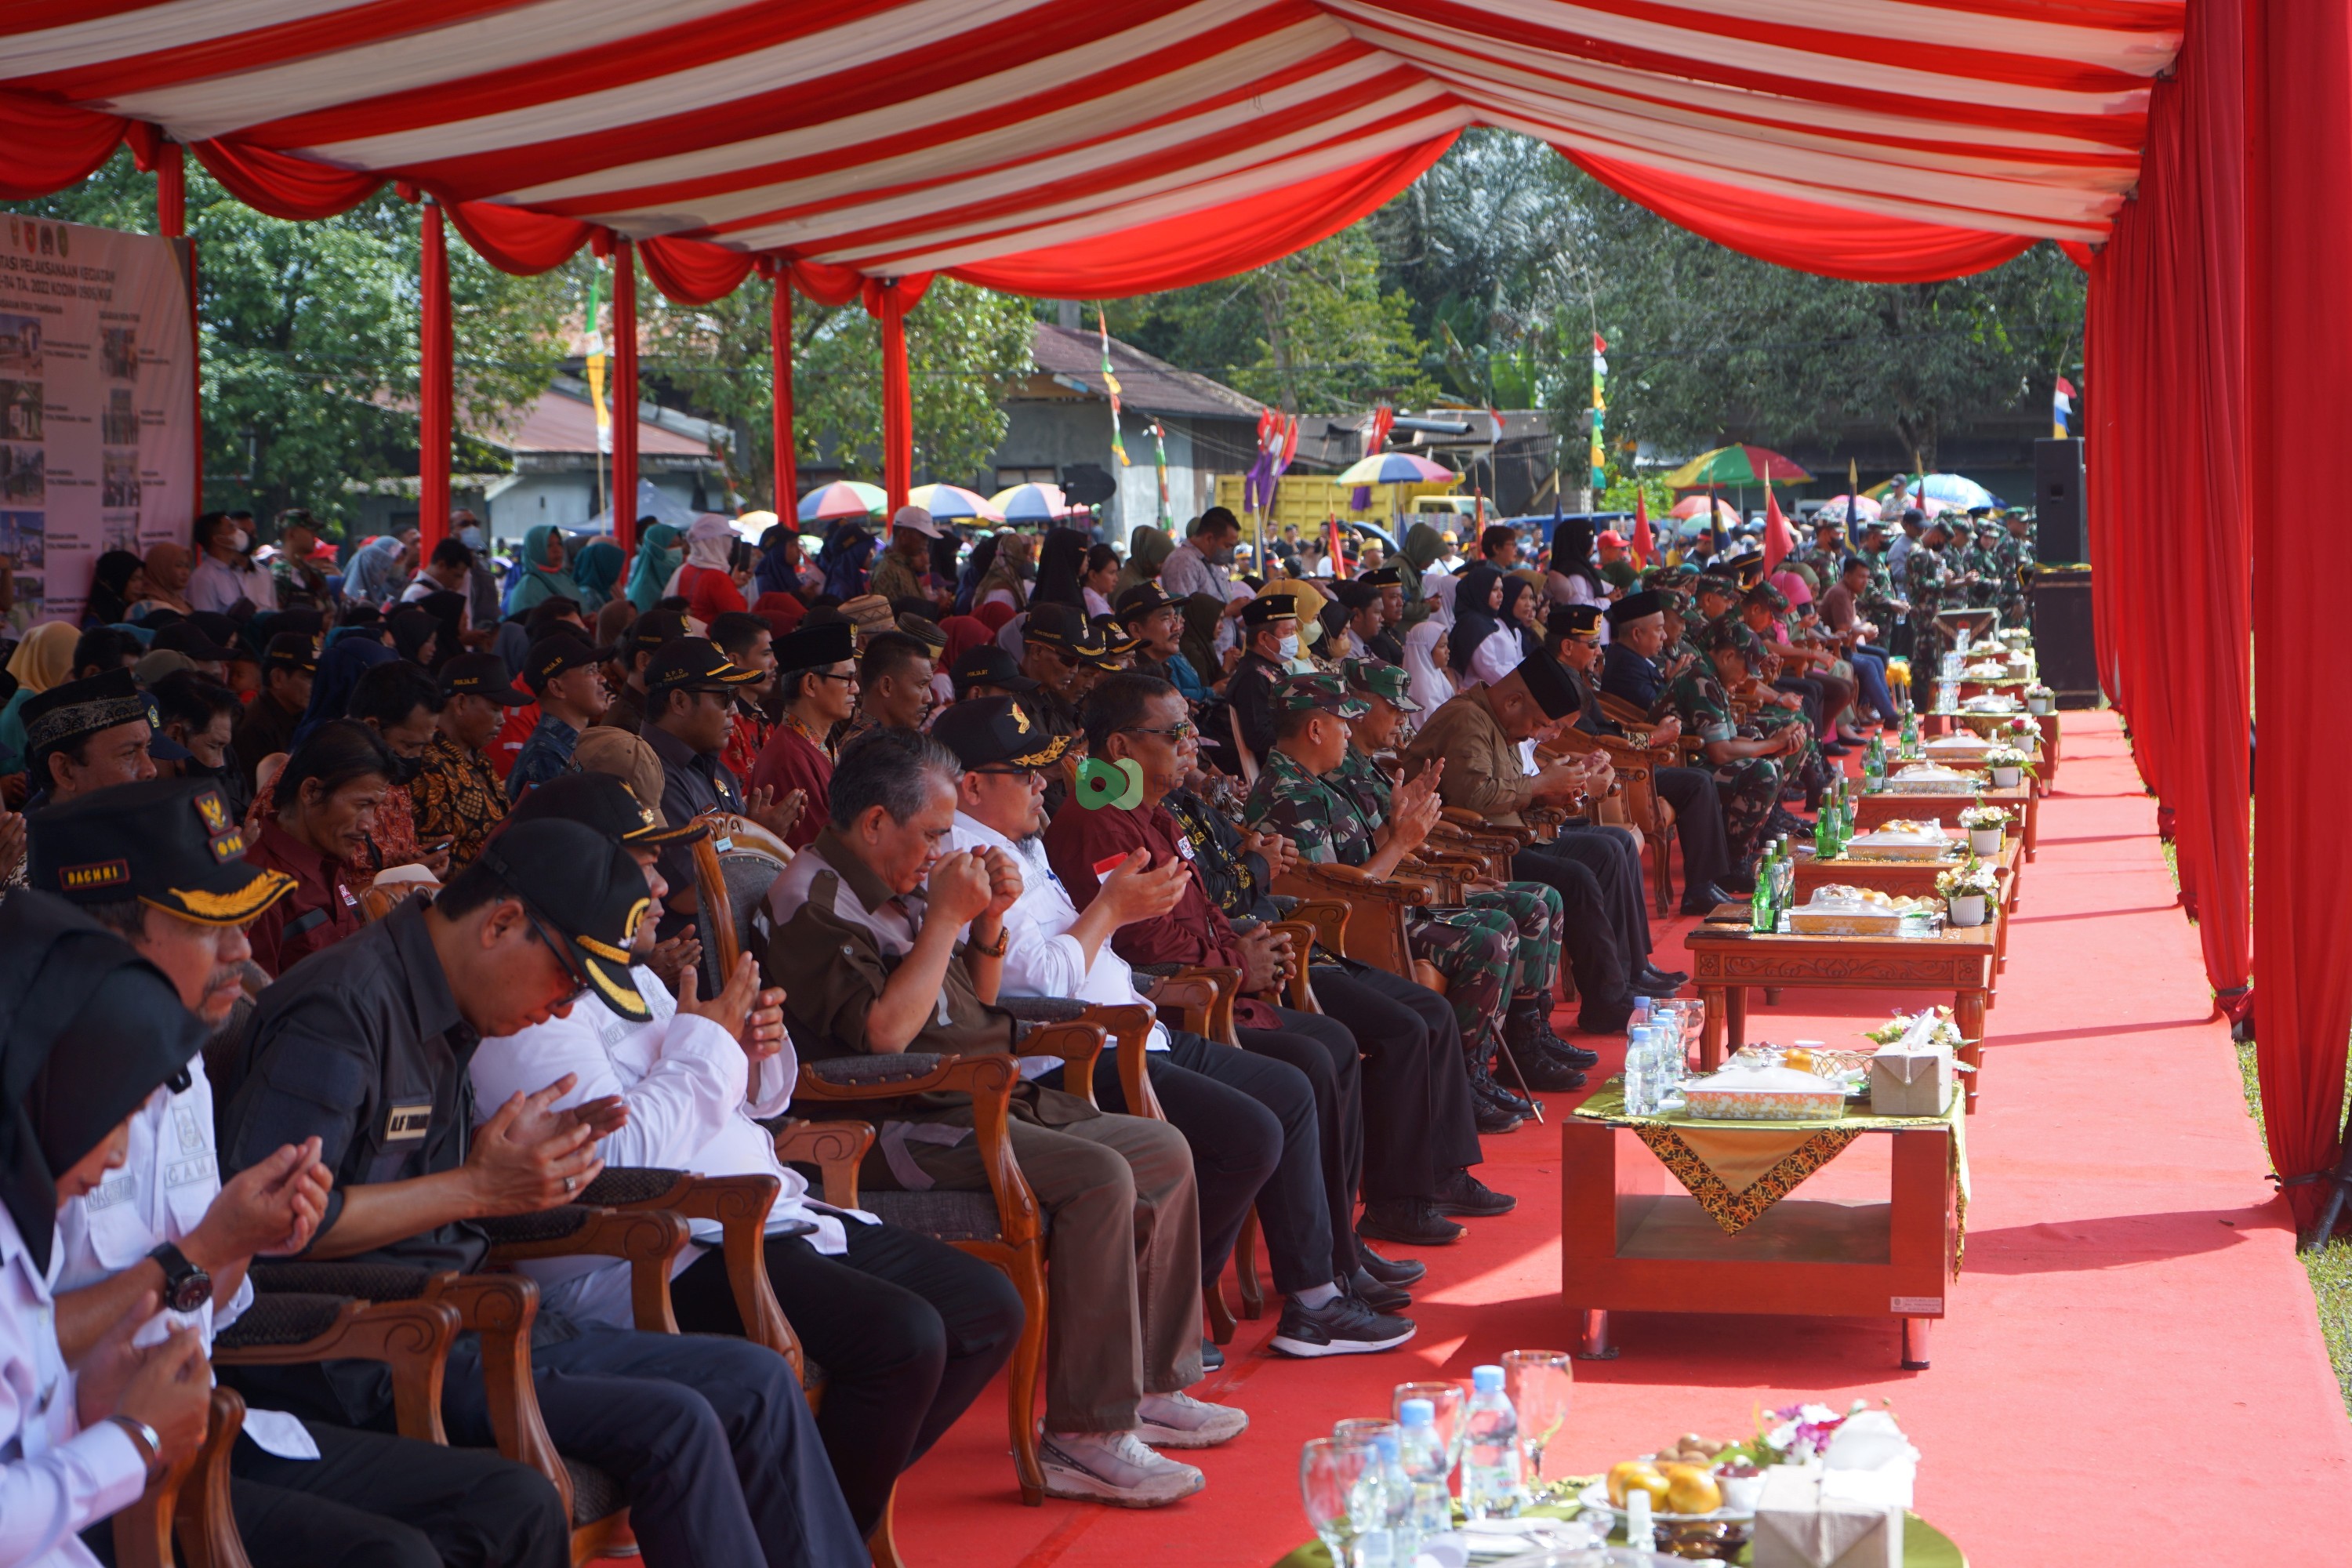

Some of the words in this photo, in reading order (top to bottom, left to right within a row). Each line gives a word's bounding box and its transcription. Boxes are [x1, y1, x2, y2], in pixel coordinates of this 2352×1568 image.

[0, 255, 18, 270] TASI
[20, 257, 78, 278] PELAKSANAAN
[31, 278, 49, 295] 2022
[51, 281, 77, 298] KODIM
